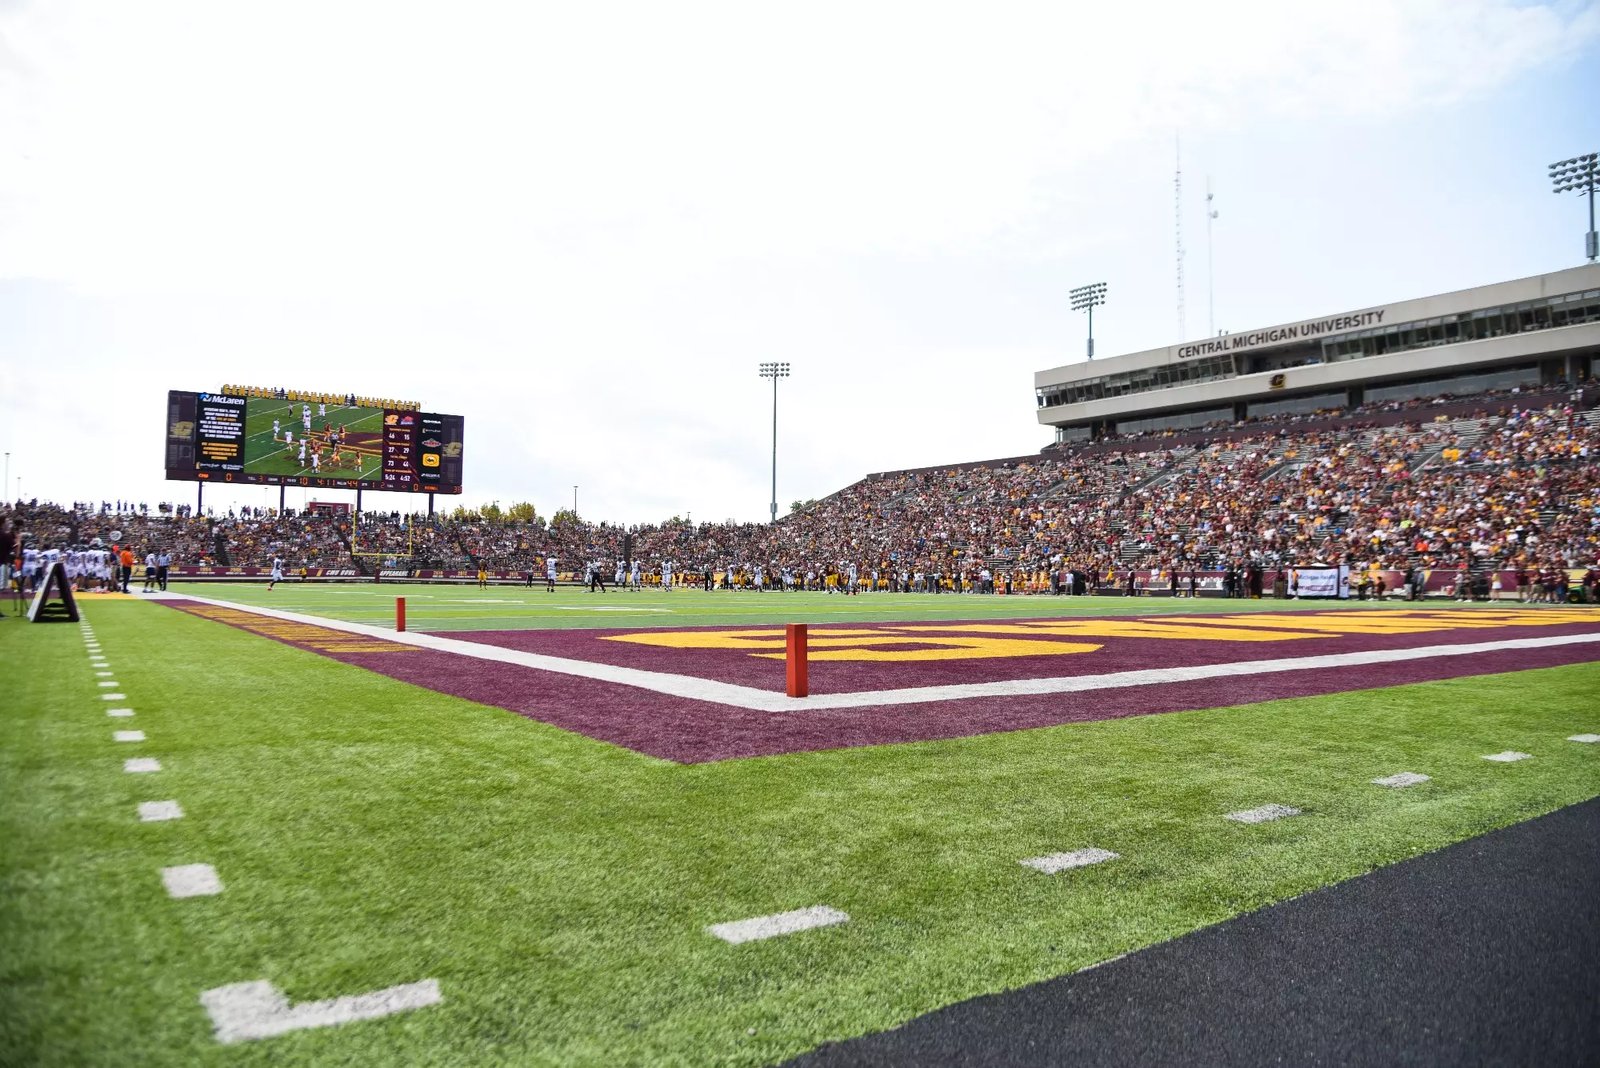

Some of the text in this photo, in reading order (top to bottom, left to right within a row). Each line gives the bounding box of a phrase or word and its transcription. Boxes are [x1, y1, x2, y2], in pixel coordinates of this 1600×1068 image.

[1178, 310, 1385, 358] CENTRAL MICHIGAN UNIVERSITY
[212, 395, 245, 405] McLaren
